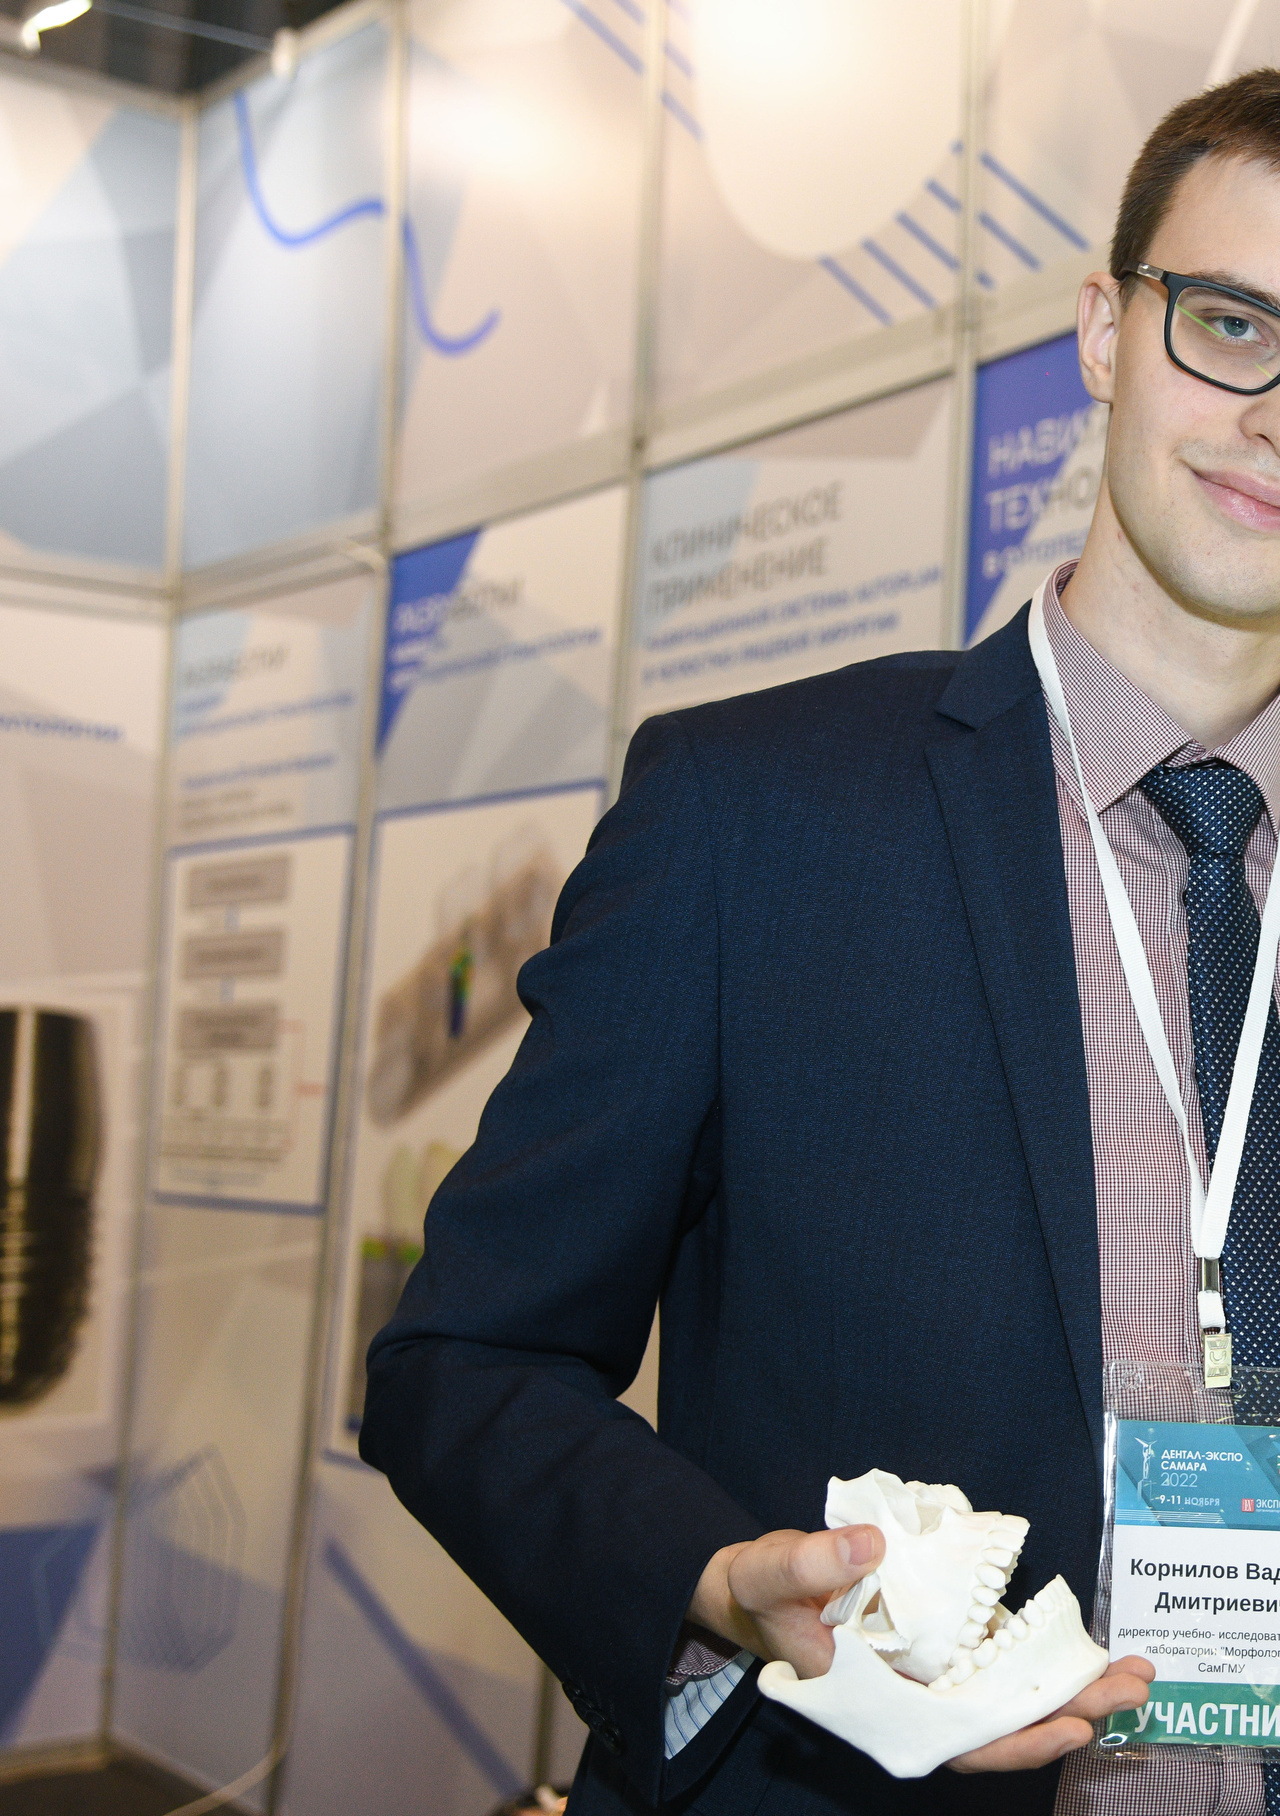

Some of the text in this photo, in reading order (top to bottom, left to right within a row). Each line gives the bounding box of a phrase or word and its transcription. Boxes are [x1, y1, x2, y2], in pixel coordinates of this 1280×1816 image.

[1161, 1449, 1243, 1462] ДЕНТАЛ-ЭКСПО
[1161, 1460, 1207, 1471] САМАРА
[1161, 1472, 1198, 1487] 2022
[1184, 1497, 1220, 1507] НОЯБРЯ
[1129, 1557, 1238, 1581] Корнилов
[1117, 1627, 1169, 1640] директор
[1171, 1627, 1215, 1640] учебно-
[1197, 1661, 1246, 1674] СамГМУ
